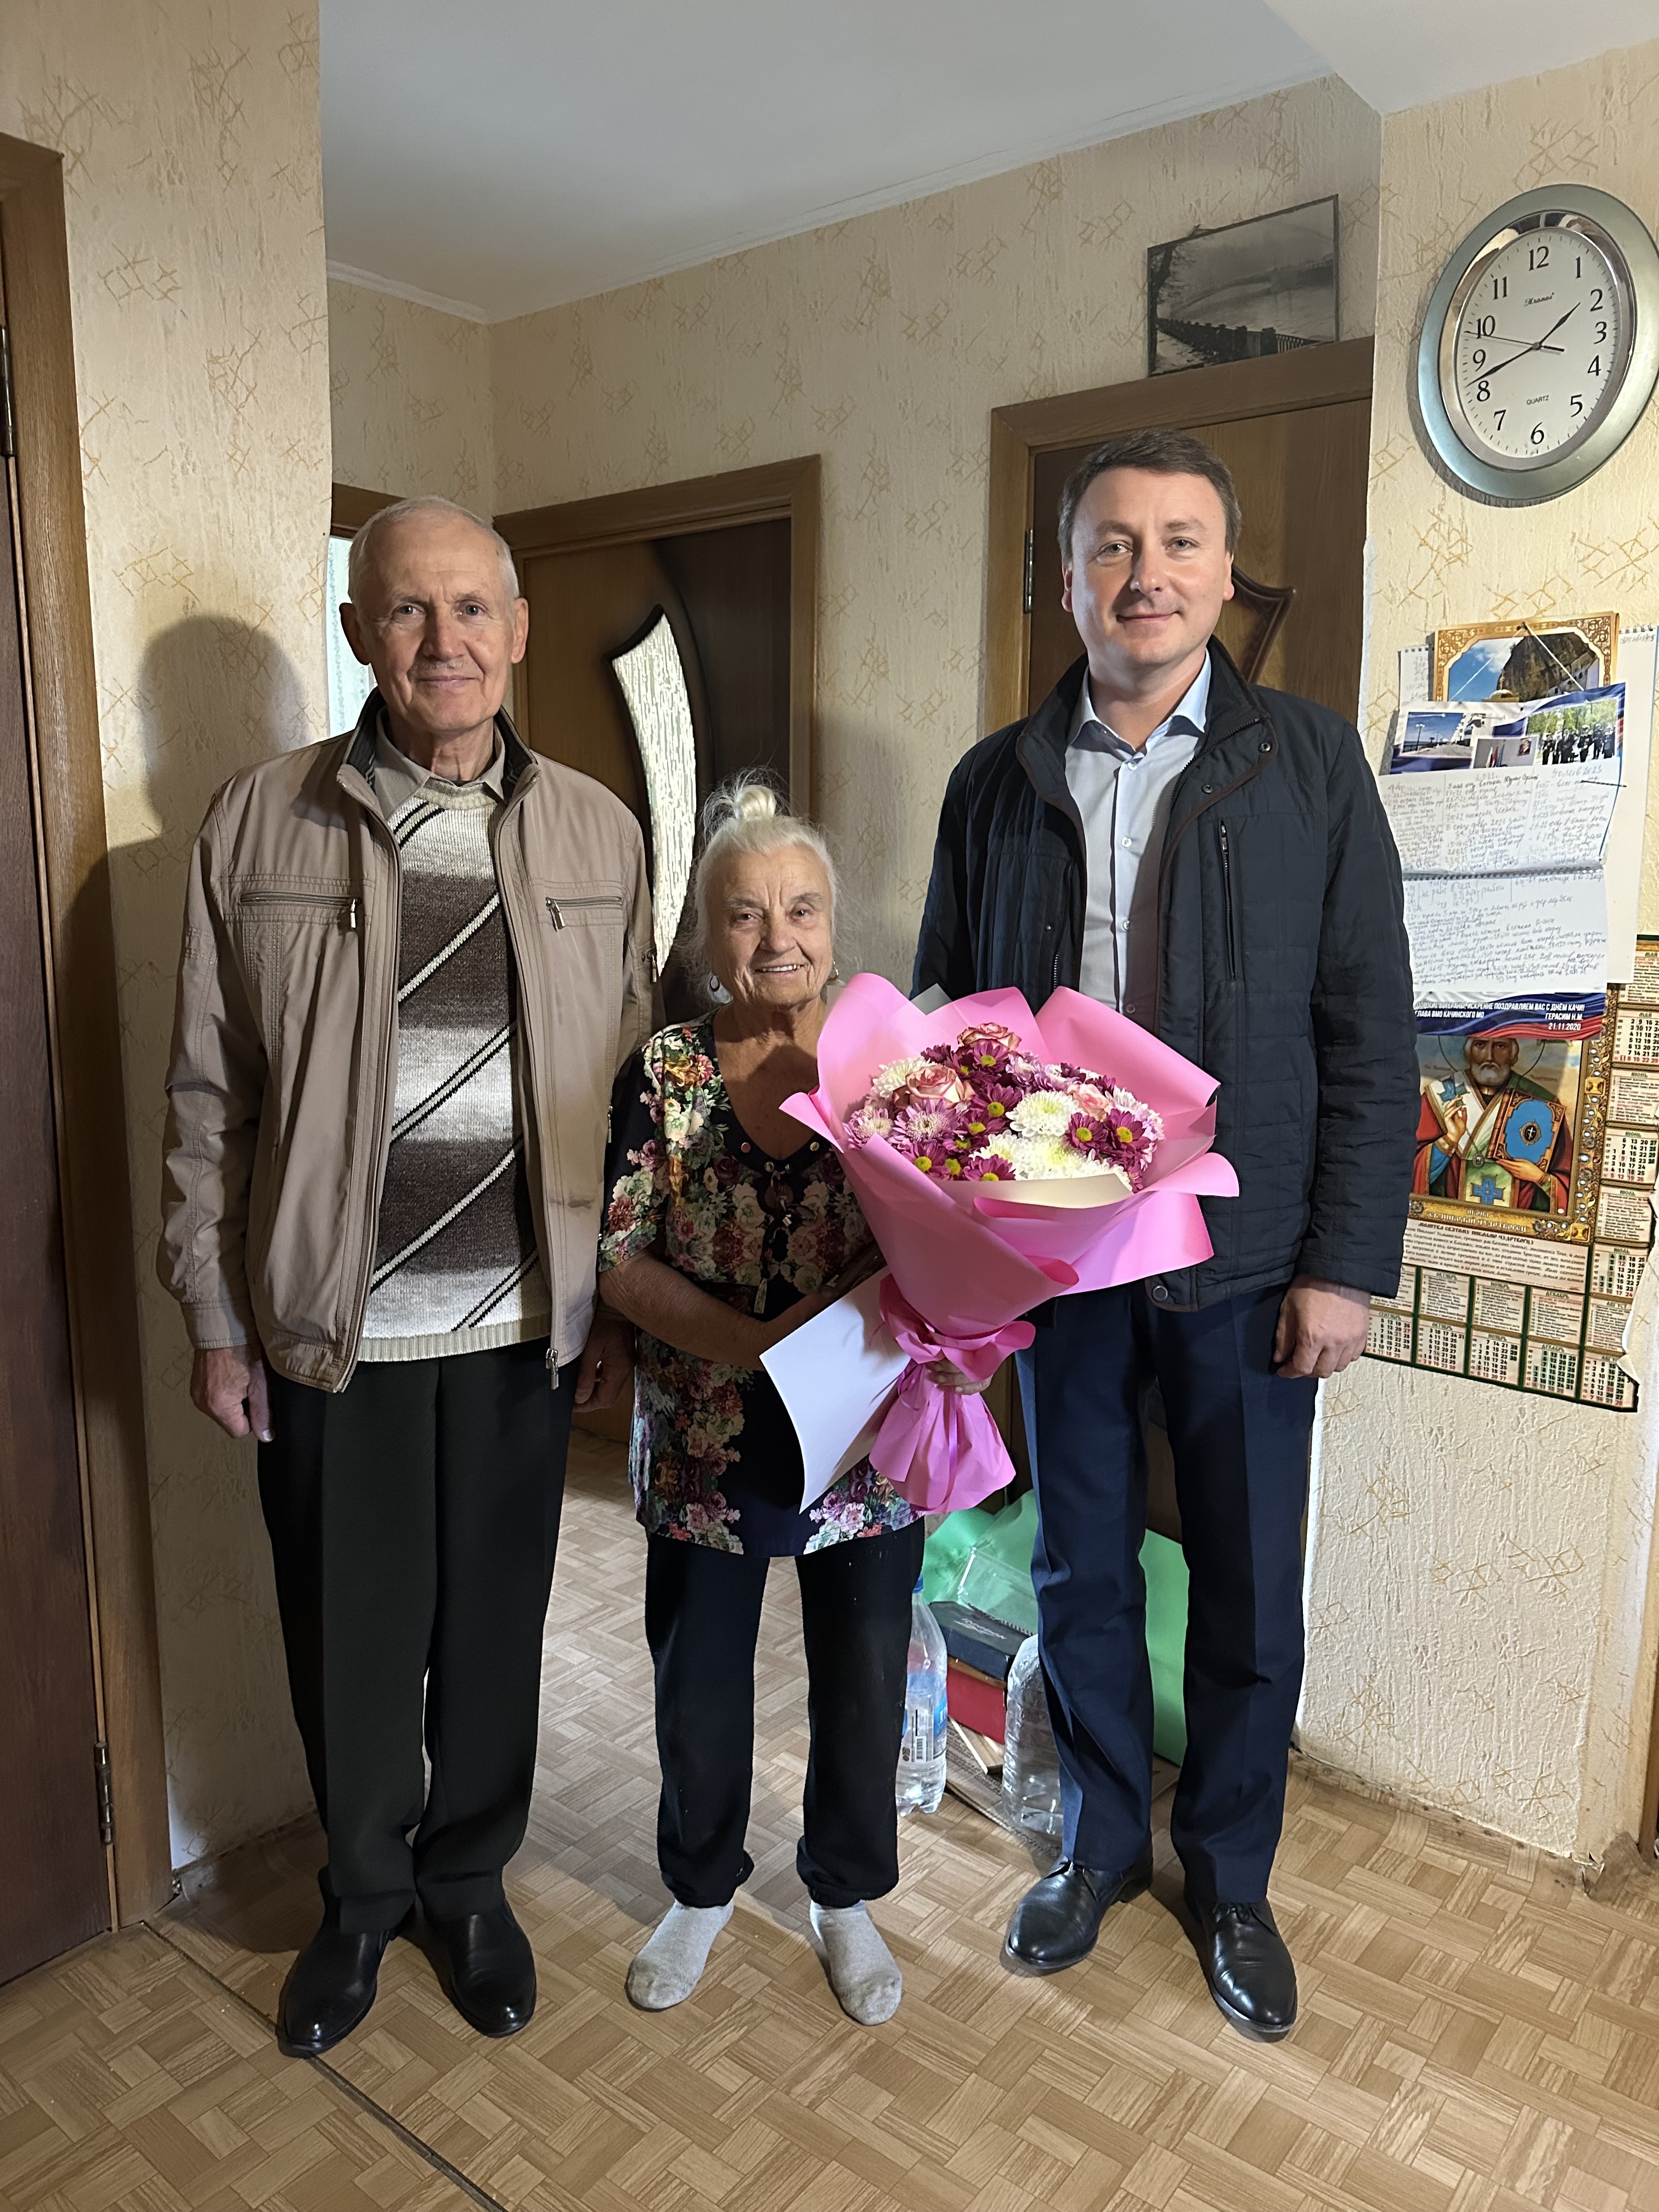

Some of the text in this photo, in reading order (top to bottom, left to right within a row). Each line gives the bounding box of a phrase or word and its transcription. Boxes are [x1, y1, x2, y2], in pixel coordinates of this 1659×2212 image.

[1528, 246, 1549, 270] 12
[1576, 257, 1582, 278] 1
[1493, 276, 1508, 300] 11
[1590, 289, 1603, 311] 2
[1476, 315, 1495, 338] 10
[1594, 321, 1606, 344] 3
[1472, 349, 1486, 371] 9
[1588, 356, 1601, 376] 4
[1476, 380, 1491, 402] 8
[1527, 395, 1549, 405] QUARTZ
[1571, 395, 1583, 417] 5
[1494, 409, 1506, 431] 7
[1531, 422, 1544, 444] 6
